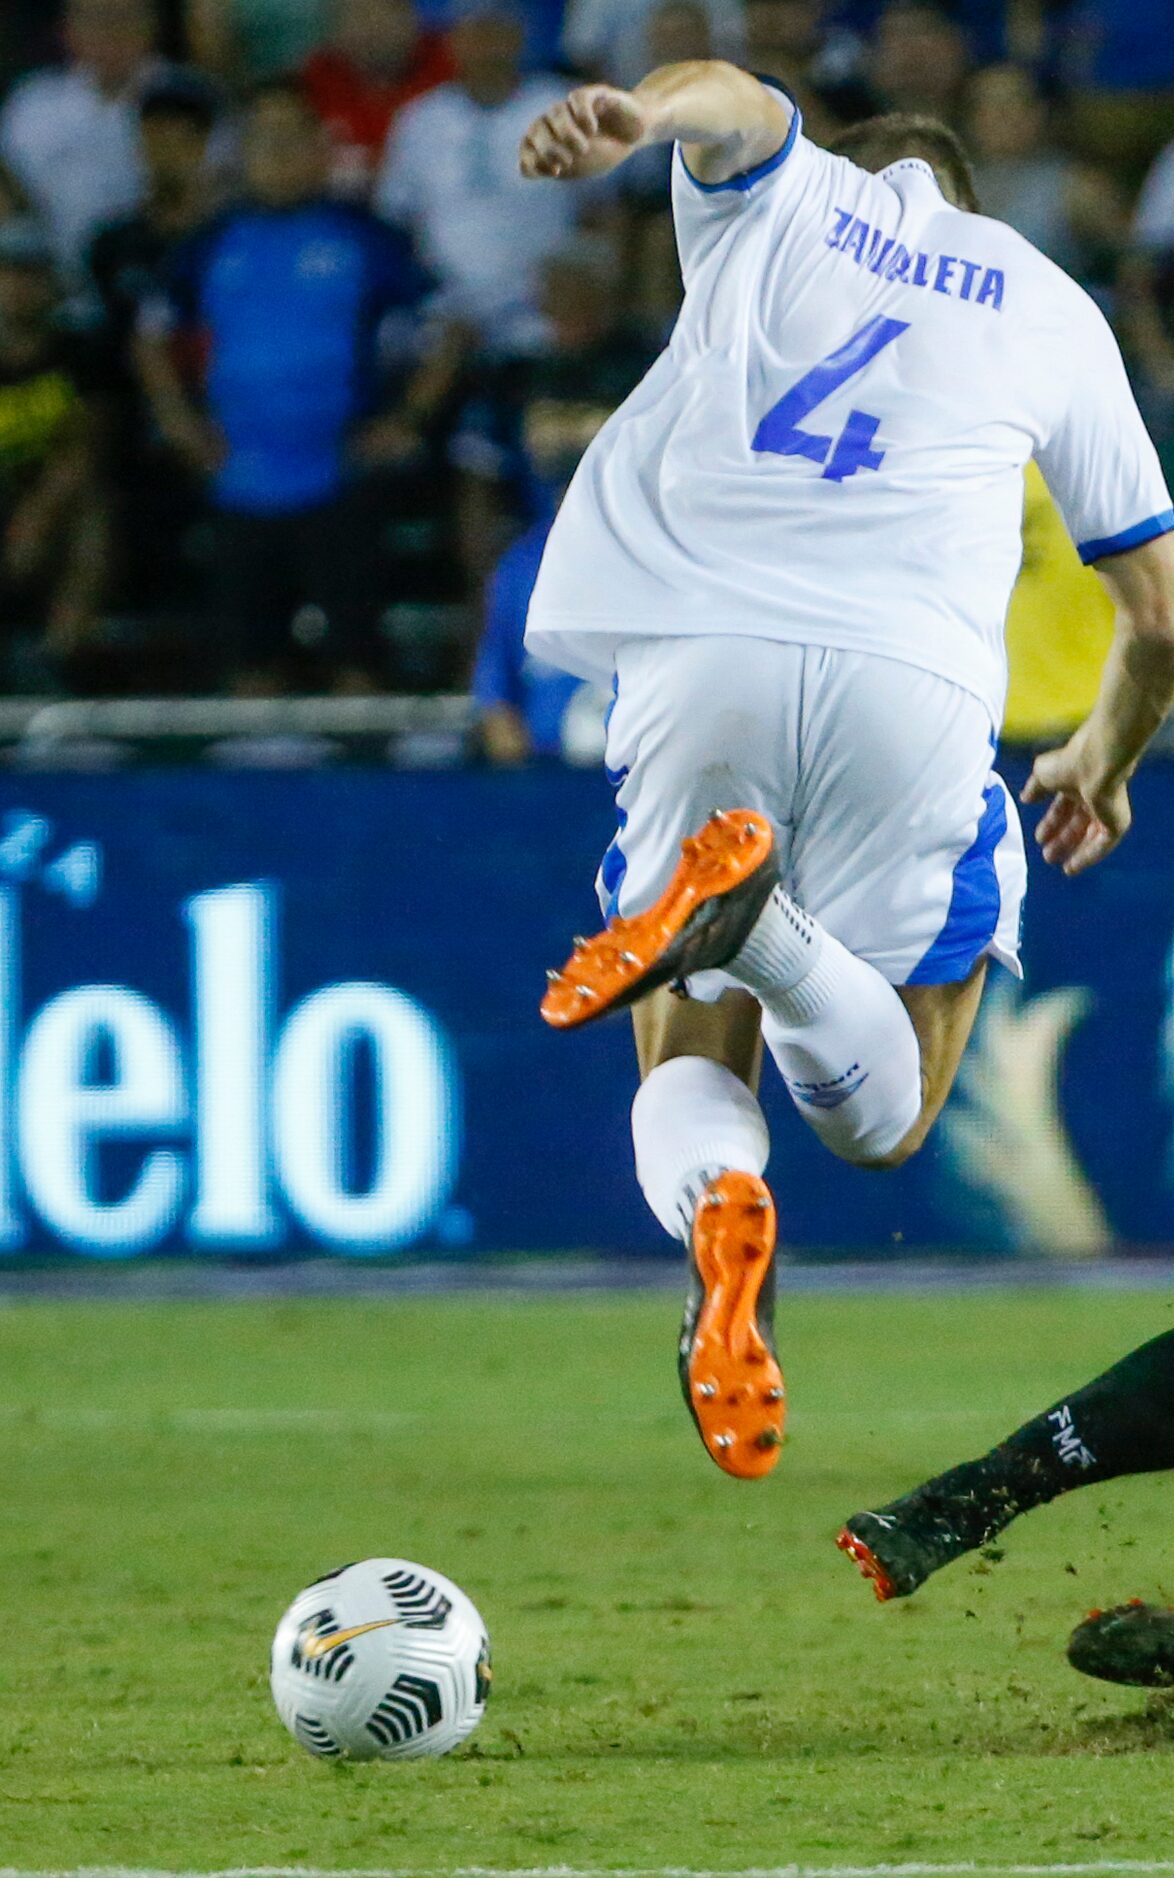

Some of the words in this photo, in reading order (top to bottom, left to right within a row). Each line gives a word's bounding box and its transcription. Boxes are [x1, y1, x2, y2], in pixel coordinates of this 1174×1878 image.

[750, 314, 911, 483] 4
[0, 880, 464, 1252] elo
[1047, 1405, 1097, 1470] FMF
